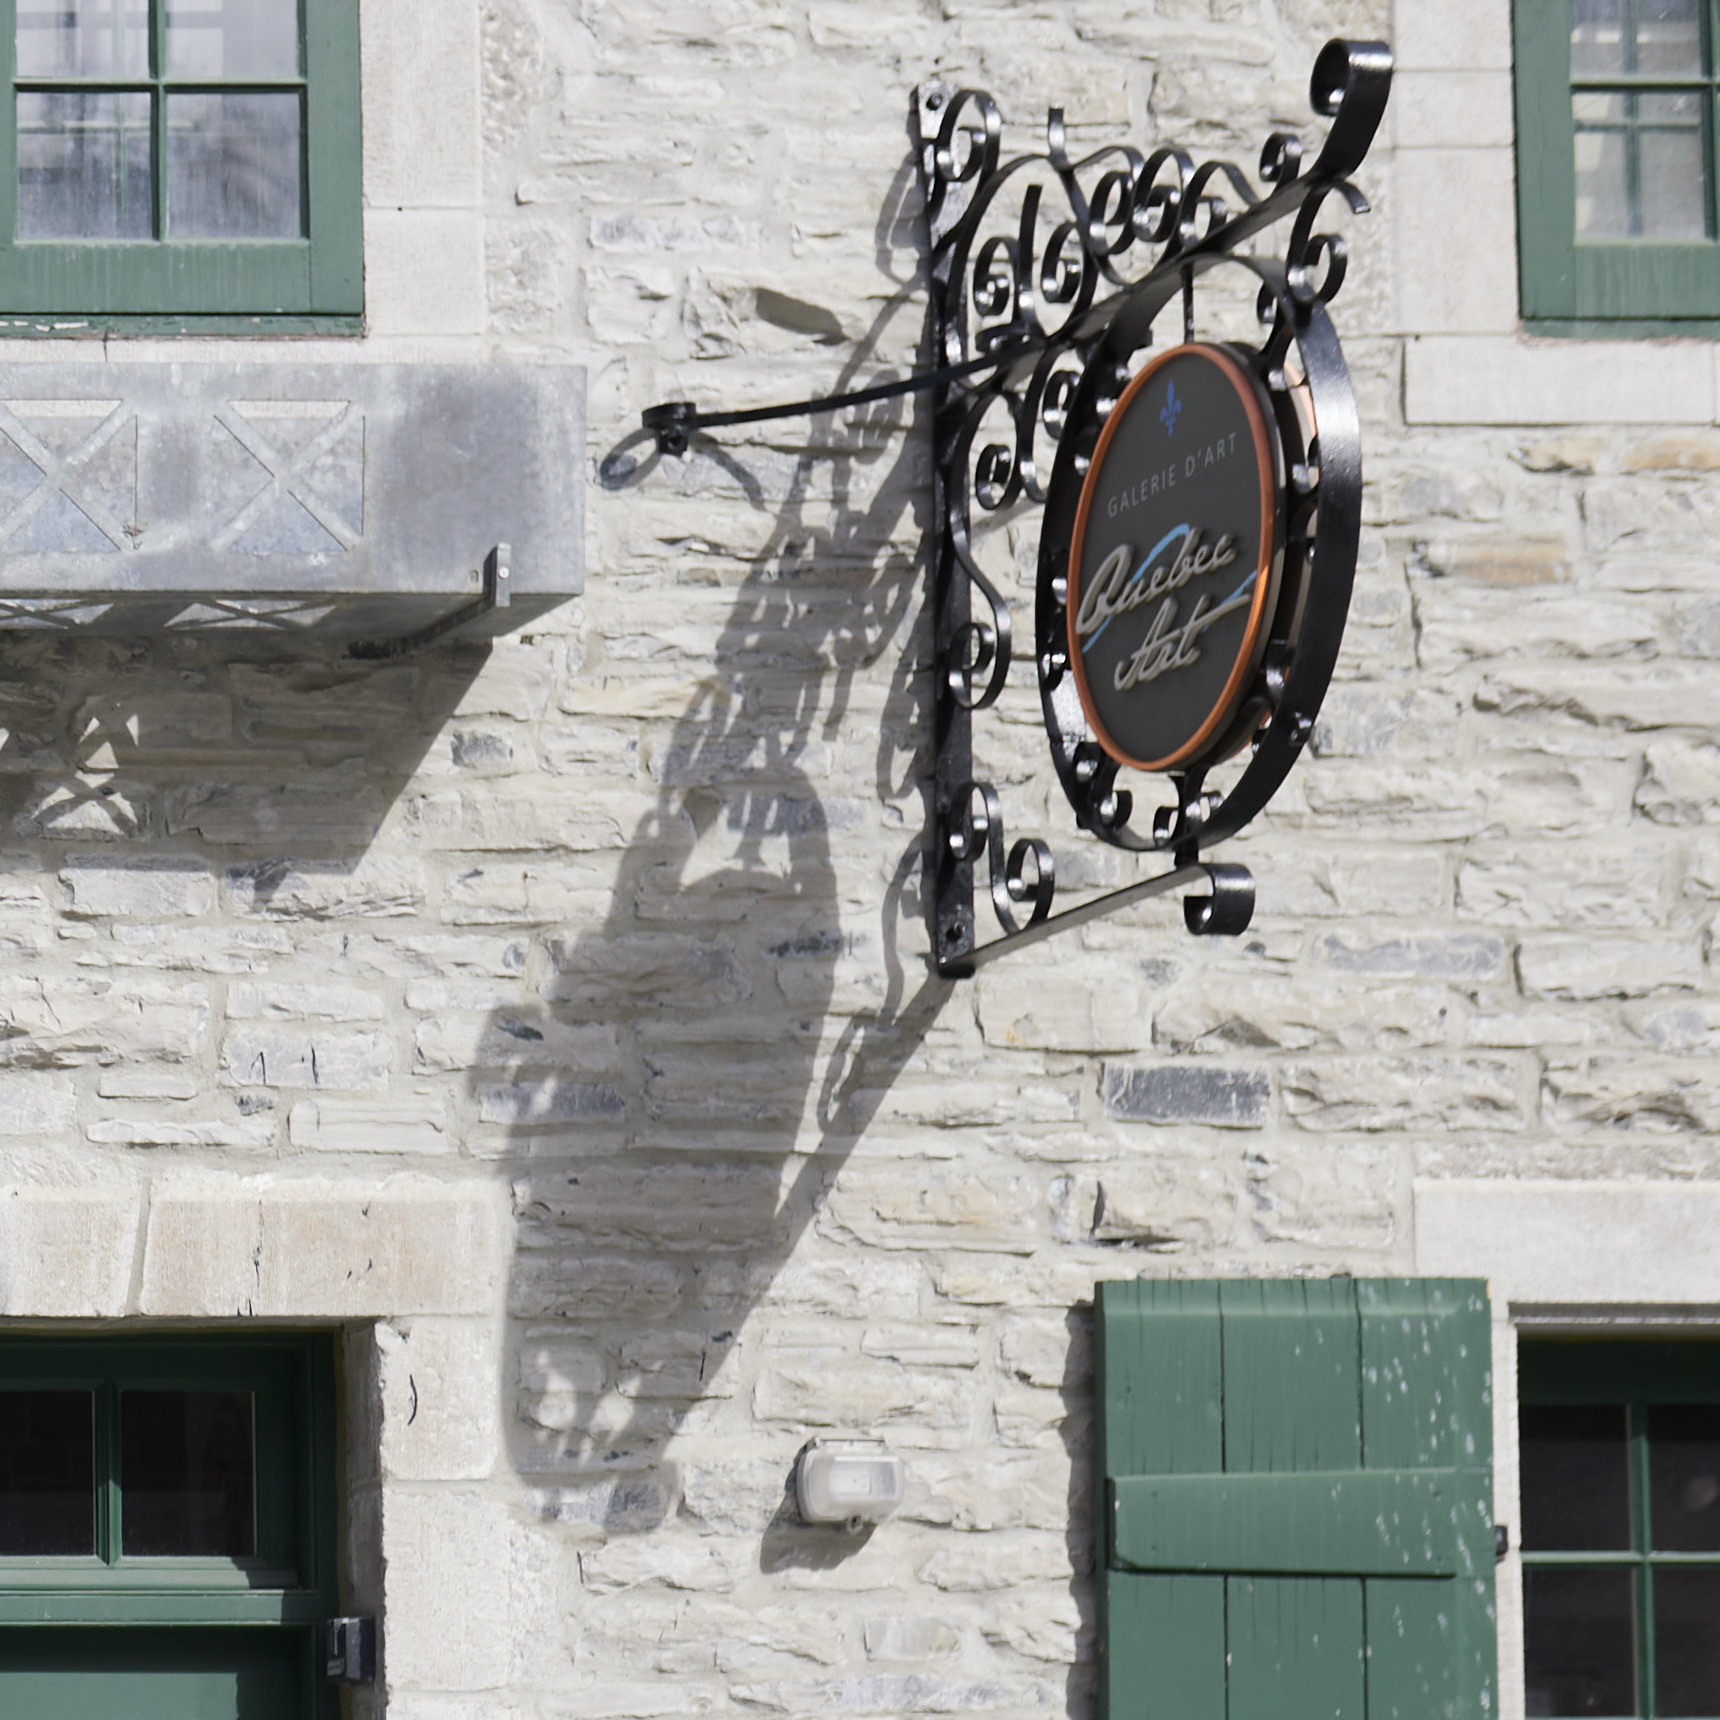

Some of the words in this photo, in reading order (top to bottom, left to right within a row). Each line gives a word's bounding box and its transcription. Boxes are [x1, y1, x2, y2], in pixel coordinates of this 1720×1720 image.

[1106, 467, 1178, 519] GALERIE
[1184, 432, 1239, 479] D'ART
[1114, 594, 1254, 691] Art
